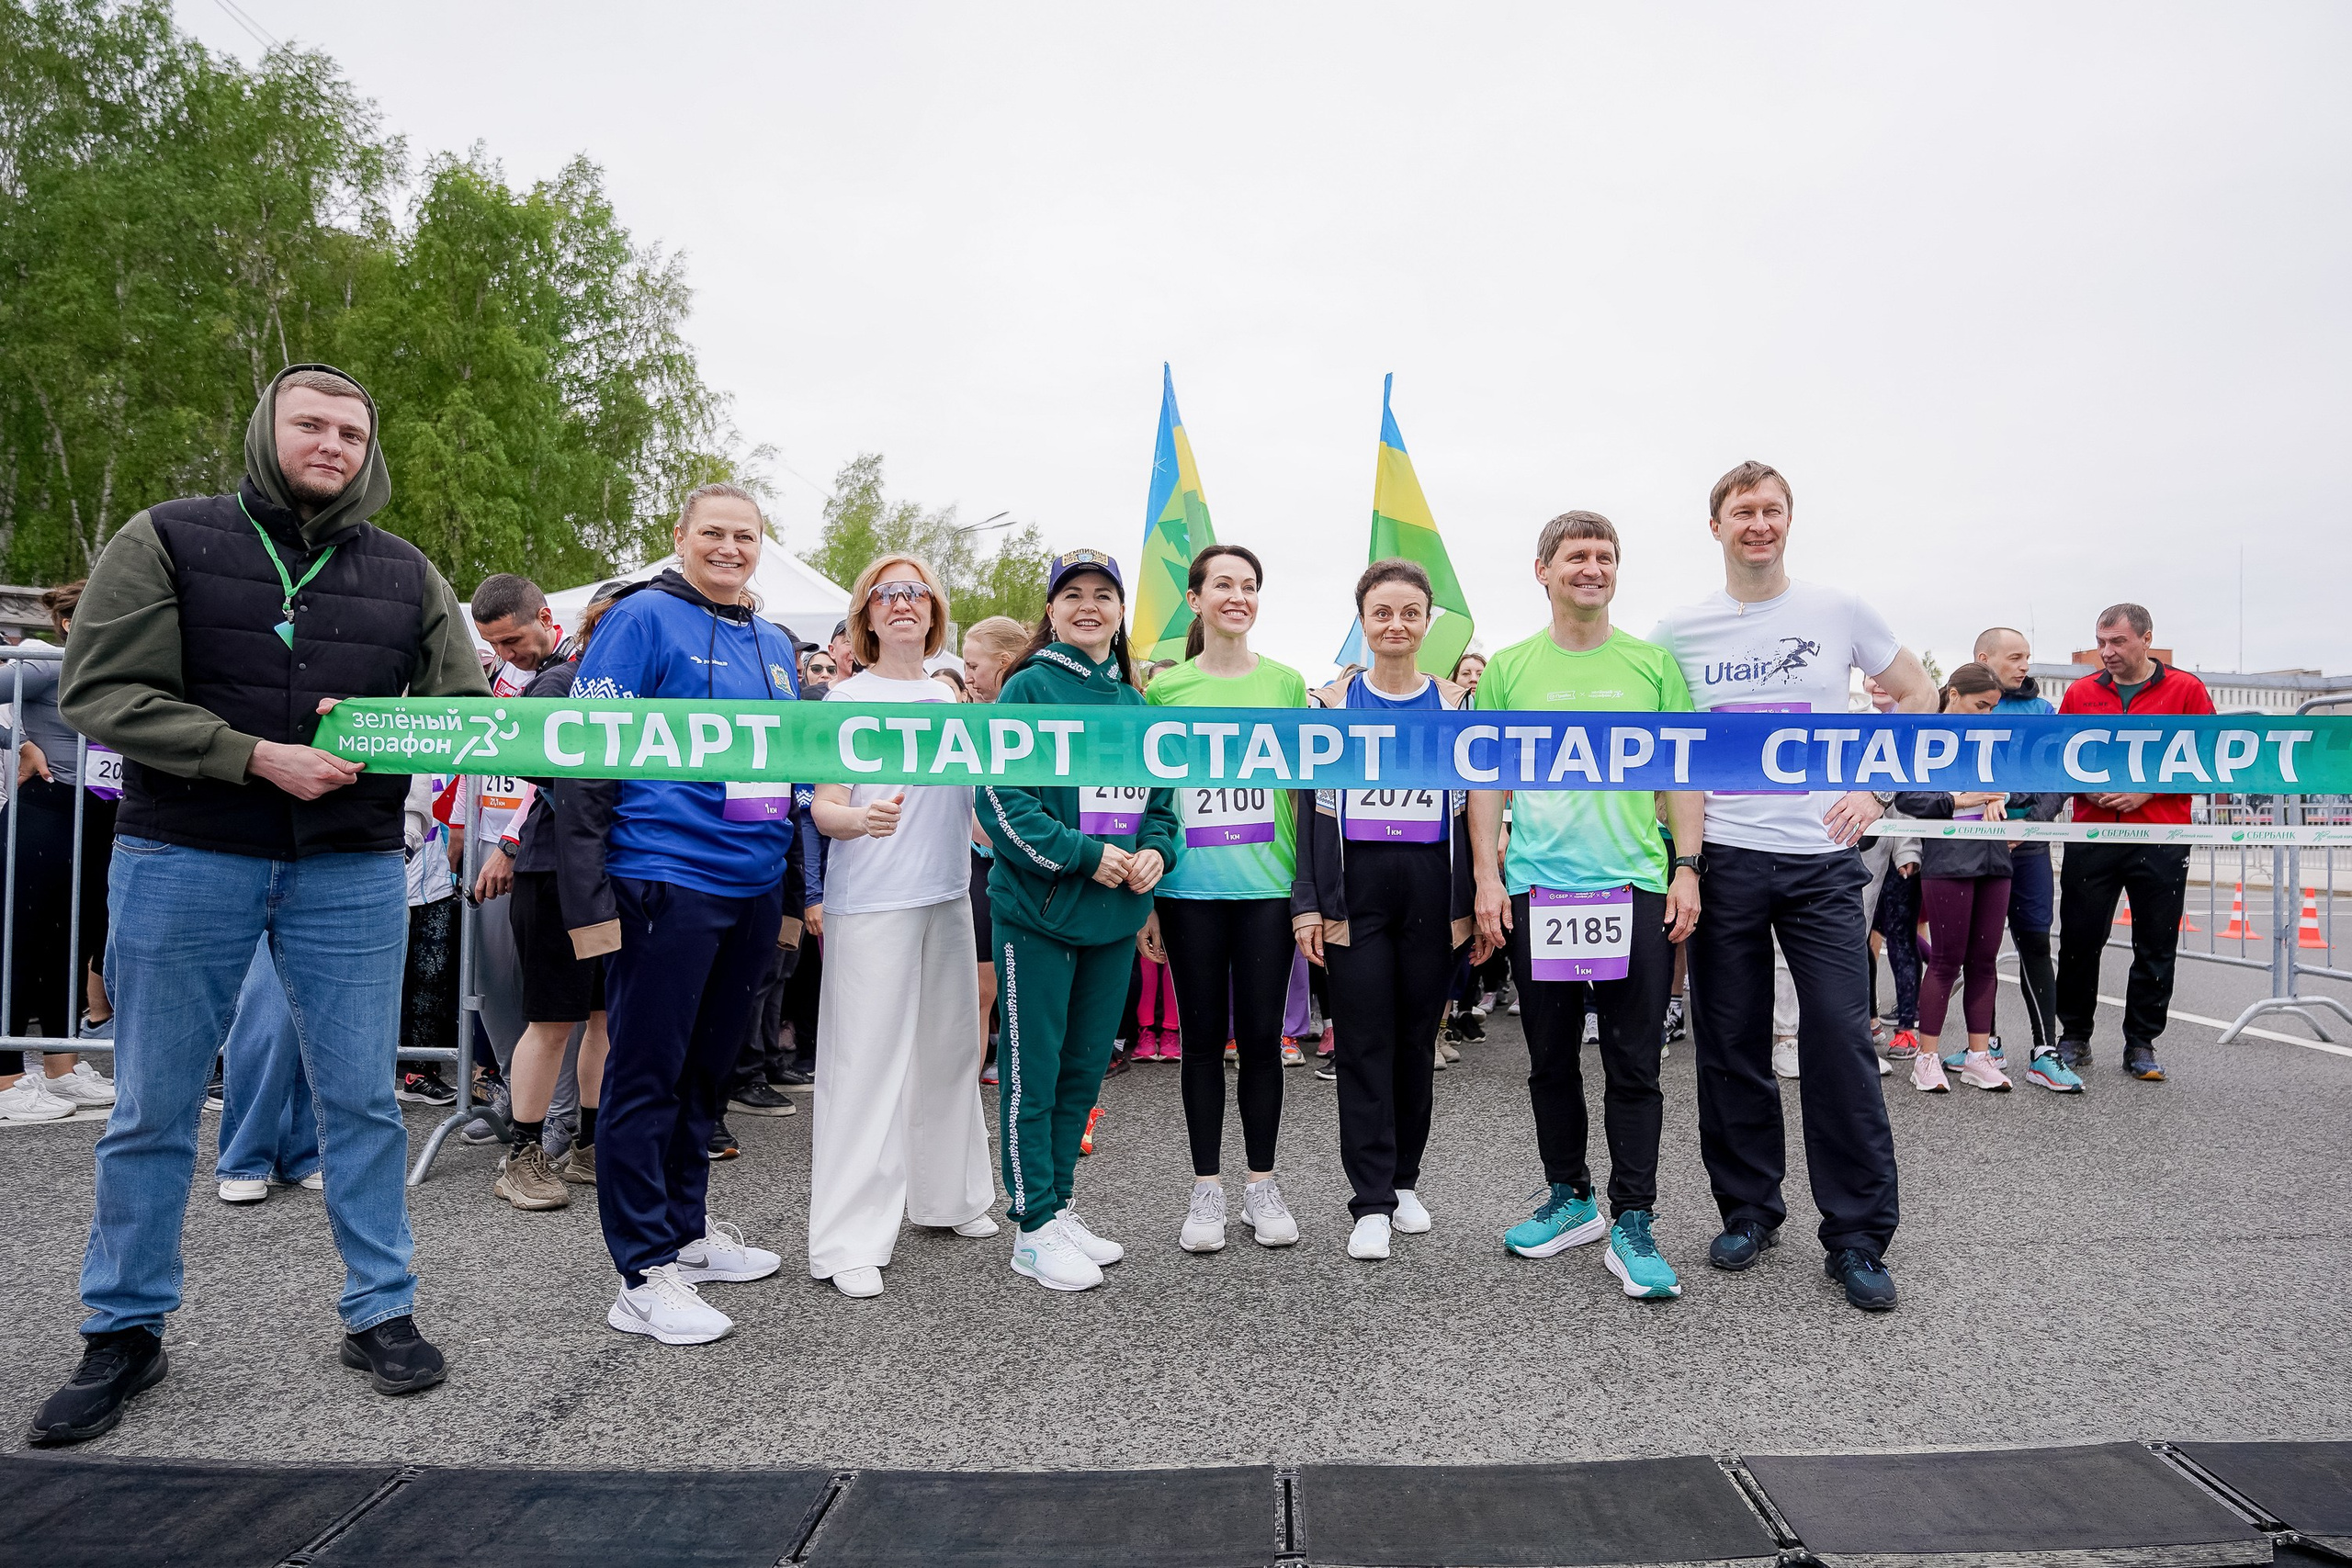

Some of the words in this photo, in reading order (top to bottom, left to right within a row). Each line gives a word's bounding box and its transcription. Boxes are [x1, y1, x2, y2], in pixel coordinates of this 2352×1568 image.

[1704, 657, 1773, 685] Utair
[352, 706, 463, 731] зелёный
[338, 731, 452, 759] марафон
[544, 710, 781, 770] СТАРТ
[839, 716, 1085, 776] СТАРТ
[1144, 721, 1396, 780] СТАРТ
[1454, 726, 1707, 783] СТАРТ
[1762, 728, 2012, 784] СТАРТ
[2064, 729, 2313, 784] СТАРТ
[1197, 788, 1265, 814] 2100
[1361, 789, 1433, 807] 2074
[1958, 827, 2007, 835] СБЕРБАНК
[2101, 829, 2150, 838] СБЕРБАНК
[2246, 831, 2296, 840] СБЕРБАНК
[1546, 916, 1623, 945] 2185
